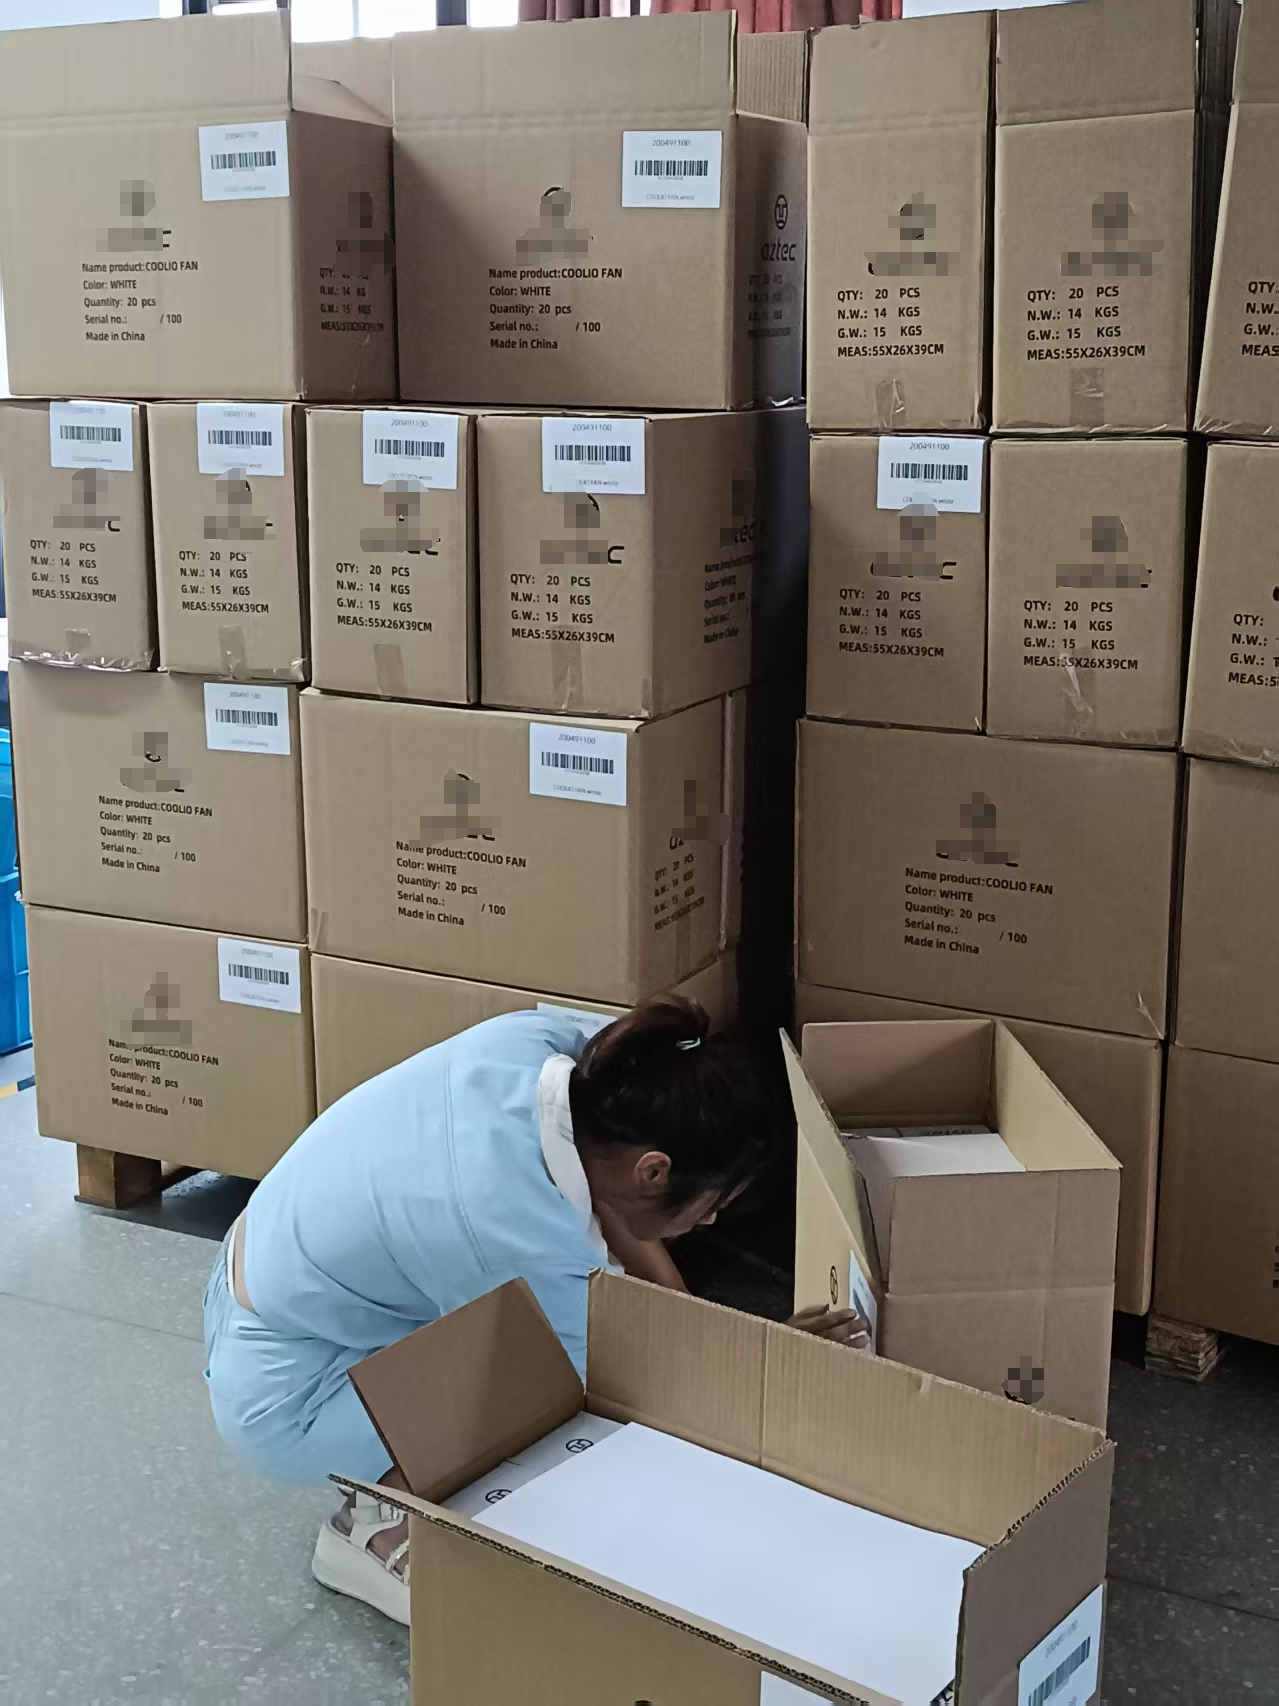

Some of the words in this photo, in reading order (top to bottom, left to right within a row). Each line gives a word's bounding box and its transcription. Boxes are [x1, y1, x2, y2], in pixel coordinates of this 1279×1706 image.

[761, 238, 796, 261] aztec
[82, 263, 107, 272] Name
[180, 261, 198, 271] FAN
[489, 268, 517, 278] Name
[601, 268, 622, 278] FAN
[83, 280, 108, 290] Color:
[110, 280, 137, 289] WHITE
[489, 286, 517, 296] Color:
[520, 286, 551, 296] WHITE
[837, 290, 863, 302] QTY:
[875, 289, 888, 299] 20
[899, 287, 920, 298] PCS
[1027, 289, 1056, 303] QTY:
[1068, 288, 1084, 299] 20
[1096, 286, 1119, 298] PCS
[84, 297, 123, 308] Quantity:
[127, 297, 138, 306] 20
[141, 298, 156, 308] pcs
[489, 304, 534, 316] Quantity:
[538, 304, 550, 314] 20
[555, 305, 571, 316] pcs
[837, 309, 868, 319] N.W.:
[874, 308, 887, 318] 14
[898, 306, 920, 317] KGS
[1027, 309, 1061, 321] N.W.:
[1068, 307, 1082, 319] 14
[1095, 306, 1119, 318] KGS
[85, 314, 109, 324] Serial
[166, 314, 182, 324] 100
[490, 321, 516, 331] Serial
[582, 322, 600, 332] 100
[837, 328, 867, 338] G.W.:
[873, 327, 886, 337] 15
[900, 325, 922, 336] KGS
[1027, 329, 1060, 341] G.W.:
[1067, 328, 1081, 339] 15
[1096, 326, 1121, 338] KGS
[85, 332, 109, 341] Made
[111, 332, 119, 341] in
[121, 331, 145, 341] China
[490, 339, 516, 348] Made
[519, 339, 528, 348] in
[530, 339, 558, 349] China
[909, 442, 950, 450] 200491100
[30, 540, 51, 550] QTY:
[60, 541, 71, 551] 20
[79, 542, 96, 553] PCS
[179, 550, 200, 561] QTY:
[209, 551, 221, 561] 20
[229, 552, 247, 562] PCS
[60, 558, 70, 567] 14
[79, 559, 97, 569] KGS
[336, 562, 359, 574] QTY:
[369, 565, 382, 575] 20
[391, 566, 410, 577] PCS
[60, 574, 70, 584] 15
[81, 576, 99, 585] KGS
[209, 568, 221, 578] 14
[229, 569, 248, 579] KGS
[510, 573, 535, 585] QTY:
[546, 575, 560, 586] 20
[570, 576, 591, 587] PCS
[210, 585, 221, 595] 15
[232, 586, 251, 596] KGS
[336, 580, 364, 591] N.W.:
[368, 582, 381, 593] 14
[390, 584, 411, 595] KGS
[510, 591, 540, 603] N.W.:
[546, 593, 559, 604] 14
[569, 594, 591, 606] KGS
[840, 588, 865, 600] QTY:
[876, 590, 890, 600] 20
[900, 591, 922, 602] PCS
[336, 598, 363, 609] G.W.:
[368, 600, 381, 611] 15
[393, 602, 413, 613] KGS
[1024, 600, 1052, 612] QTY:
[1064, 601, 1079, 612] 20
[1091, 601, 1113, 612] PCS
[511, 610, 540, 621] G.W.:
[546, 611, 558, 622] 15
[572, 613, 593, 624] KGS
[839, 606, 869, 617] N.W.:
[876, 608, 888, 618] 14
[899, 609, 921, 620] KGS
[1233, 613, 1264, 626] QTY:
[839, 624, 868, 635] G.W.:
[874, 625, 887, 636] 15
[901, 627, 923, 638] KGS
[1024, 619, 1056, 630] N.W.:
[1063, 620, 1077, 630] 14
[1089, 620, 1113, 631] KGS
[1024, 637, 1055, 648] G.W.:
[1062, 638, 1076, 649] 15
[1091, 639, 1115, 650] KGS
[1231, 633, 1268, 646] N.W.:
[1229, 652, 1265, 666] G.W.:
[98, 795, 123, 806] Name
[194, 806, 213, 817] FAN
[126, 814, 153, 825] WHITE
[142, 832, 153, 841] 20
[156, 834, 171, 843] pcs
[101, 842, 124, 853] Serial
[180, 852, 196, 862] 100
[101, 857, 125, 868] Made
[126, 860, 135, 869] in
[136, 862, 160, 873] China
[396, 858, 424, 870] Color:
[427, 862, 457, 875] WHITE
[505, 856, 527, 868] FAN
[397, 874, 440, 890] Quantity:
[445, 881, 457, 891] 20
[461, 885, 478, 895] pcs
[905, 867, 937, 881] Name
[1029, 883, 1053, 895] FAN
[905, 884, 937, 897] Color:
[939, 889, 974, 902] WHITE
[397, 891, 424, 903] Serial
[488, 904, 506, 915] 100
[398, 907, 424, 919] Made
[426, 910, 435, 920] in
[437, 913, 465, 925] China
[905, 901, 955, 918] Quantity:
[959, 908, 973, 919] 20
[977, 911, 996, 923] pcs
[904, 918, 935, 931] Serial
[1007, 932, 1028, 944] 100
[904, 935, 933, 948] Made
[935, 938, 946, 949] in
[949, 941, 980, 955] China
[135, 1058, 161, 1070] WHITE
[201, 1055, 219, 1066] FAN
[151, 1075, 161, 1085] 20
[165, 1079, 179, 1089] pcs
[111, 1082, 133, 1094] Serial
[188, 1097, 203, 1108] 100
[111, 1097, 134, 1109] Made
[135, 1101, 143, 1110] in
[145, 1103, 169, 1116] China
